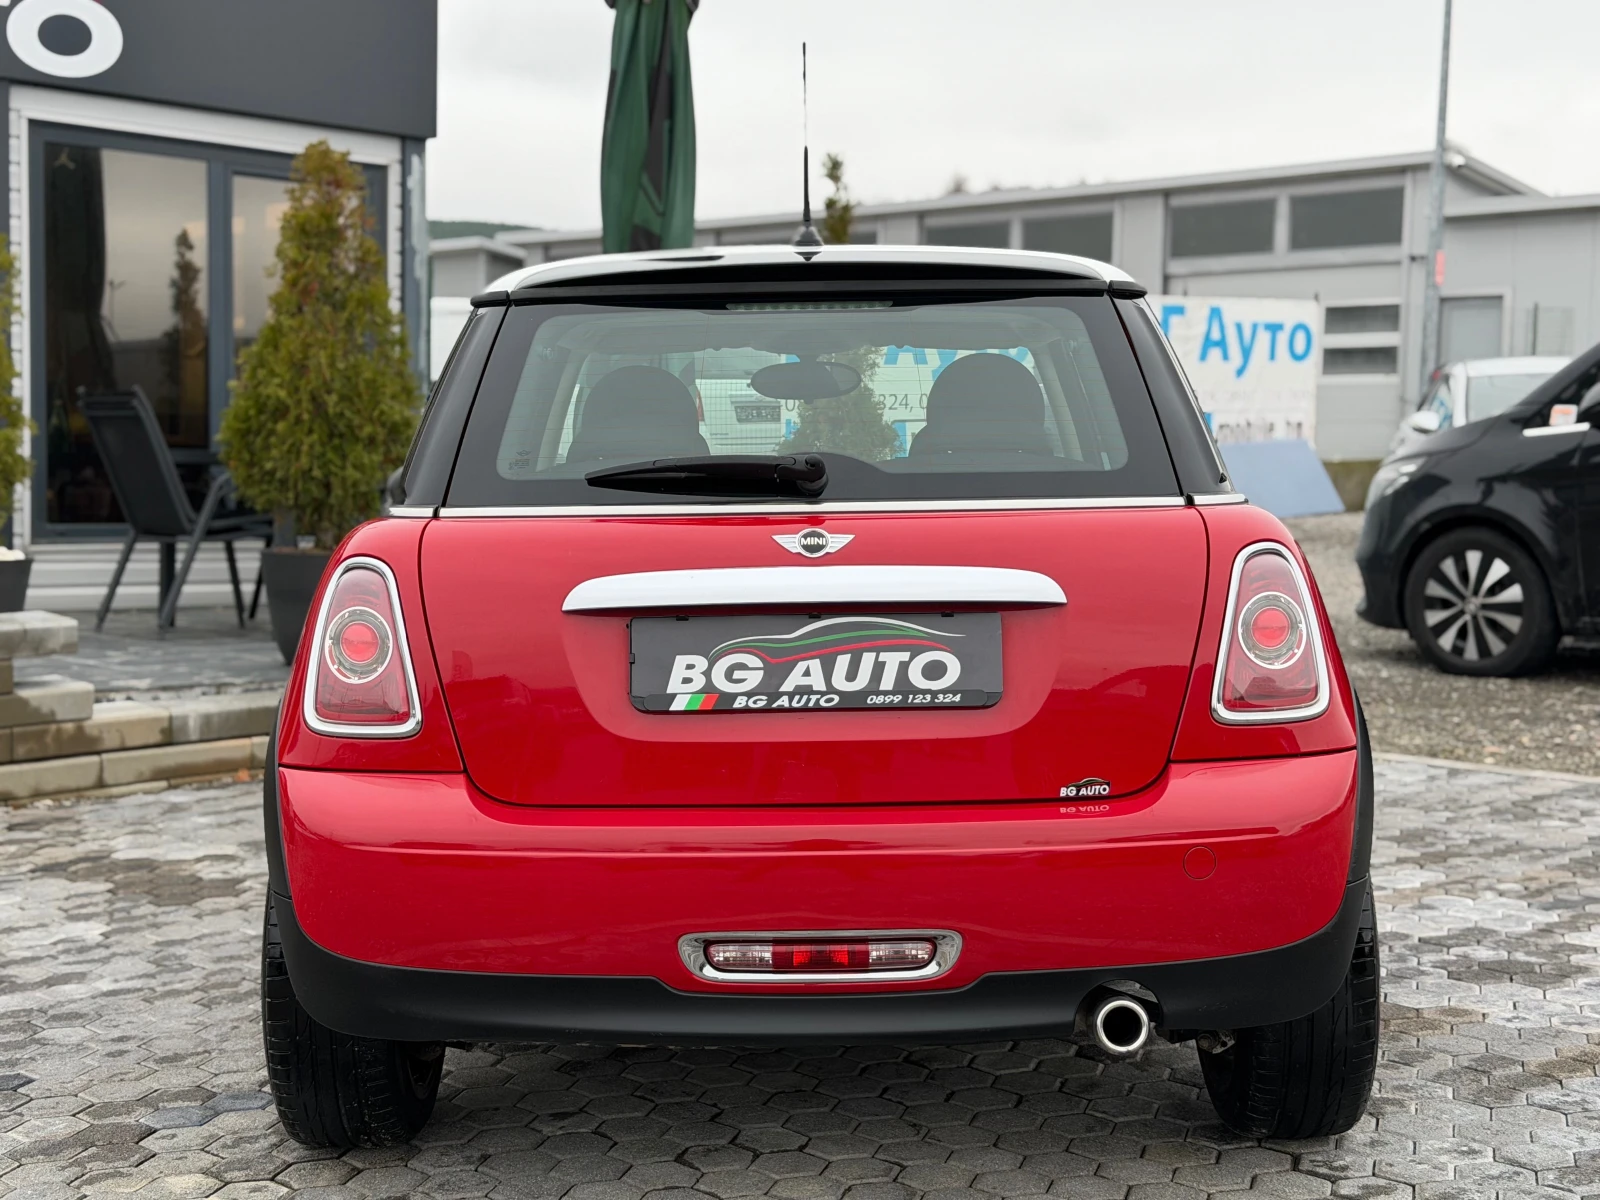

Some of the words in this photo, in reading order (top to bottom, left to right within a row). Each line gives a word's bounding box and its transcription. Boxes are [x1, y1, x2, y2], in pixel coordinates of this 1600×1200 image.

[1199, 306, 1313, 379] Ауто
[800, 537, 826, 546] MINI
[666, 652, 765, 694] BG
[779, 650, 962, 692] AUTO
[732, 695, 768, 708] BG
[772, 694, 840, 708] AUTO
[866, 694, 903, 704] 0899
[906, 694, 933, 703] 123
[934, 693, 962, 703] 324
[1060, 786, 1077, 797] BG
[1079, 785, 1109, 796] AUTO
